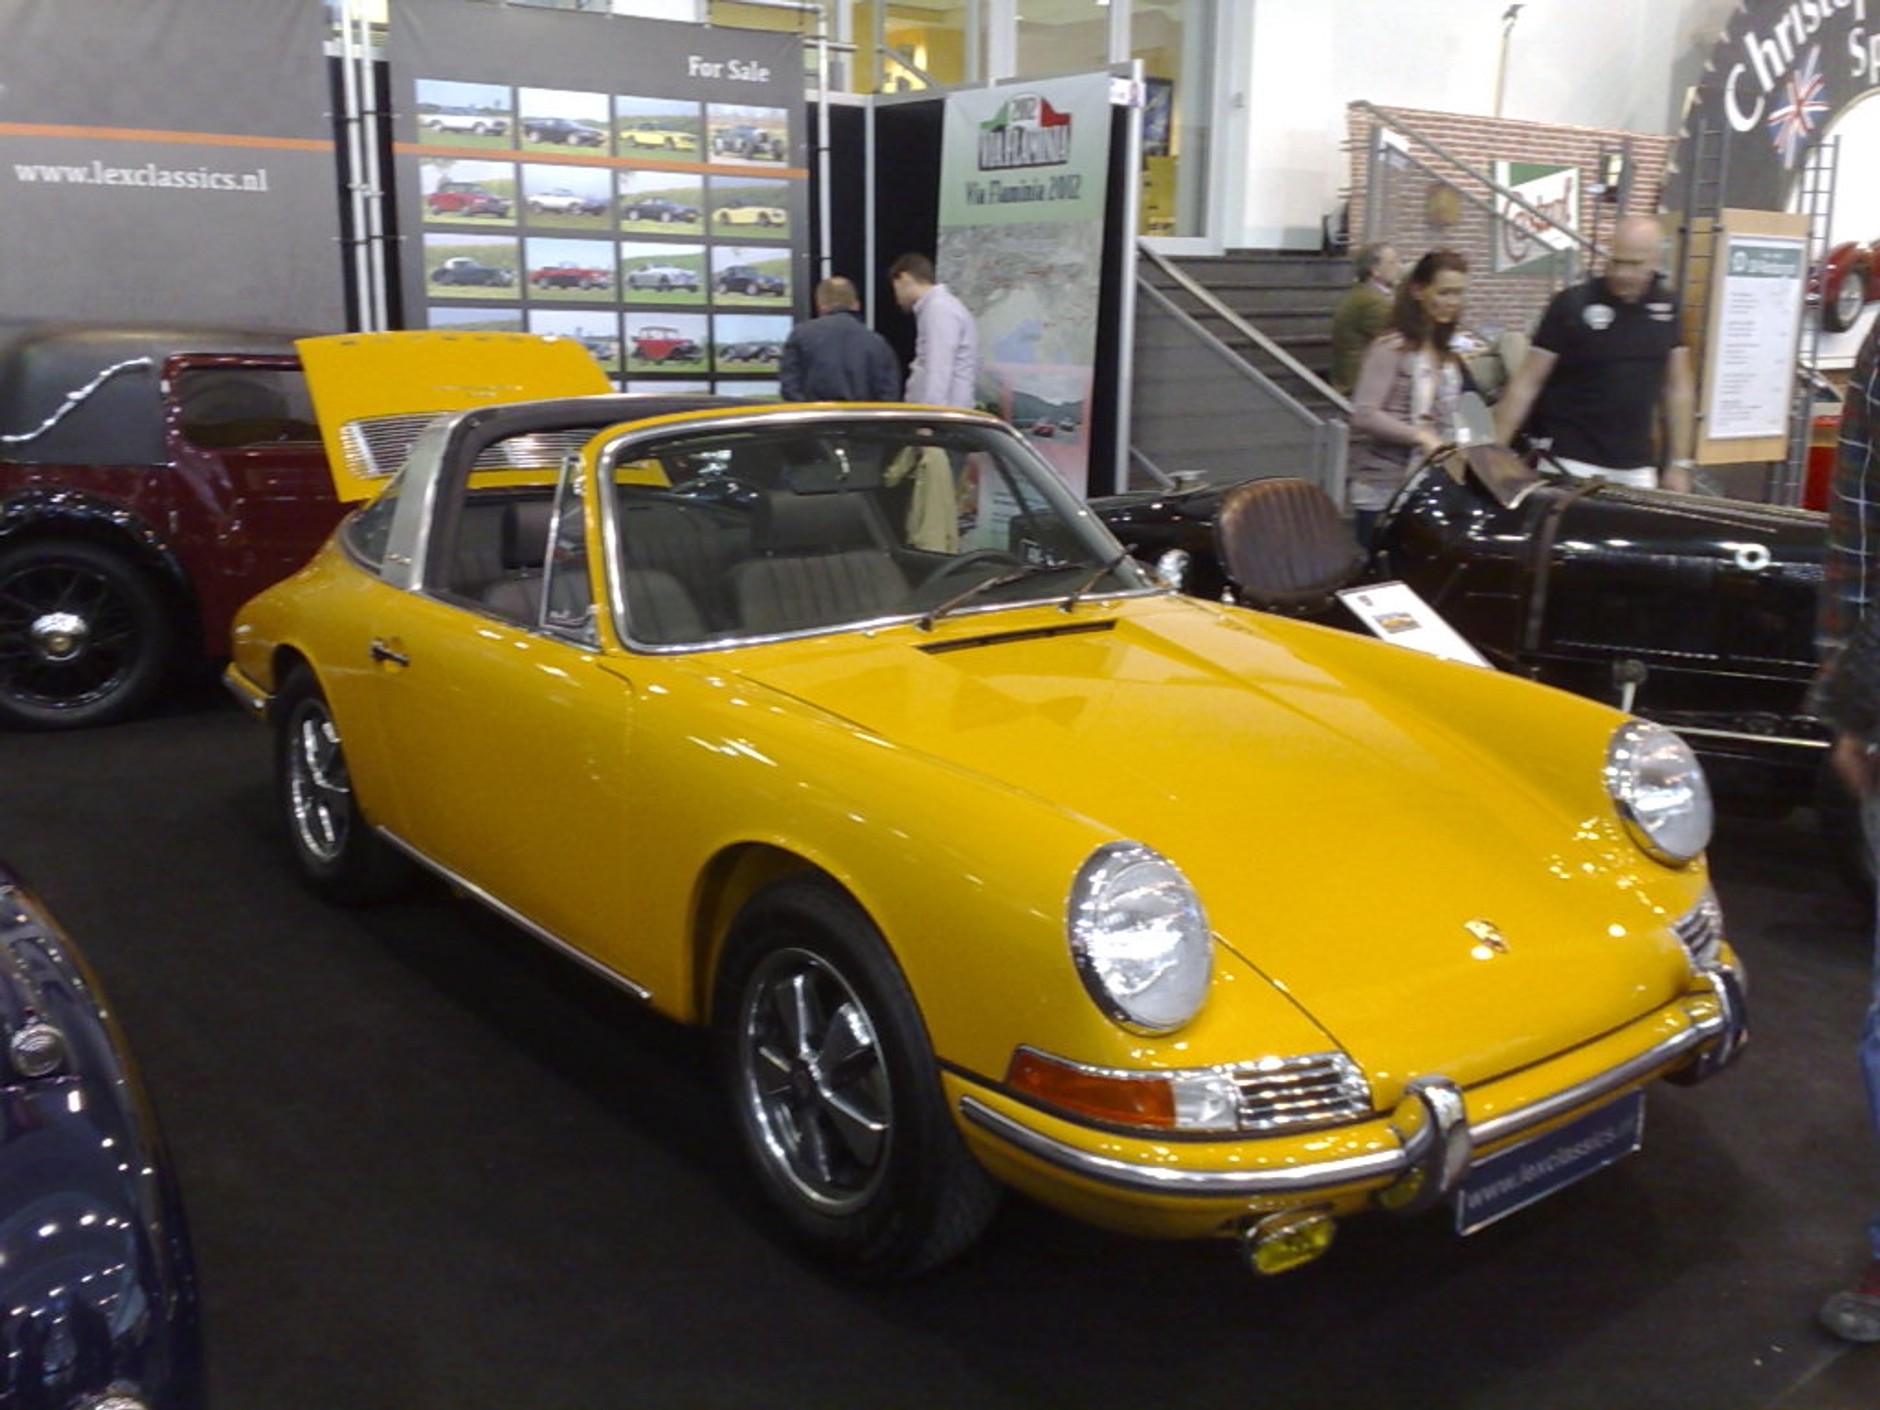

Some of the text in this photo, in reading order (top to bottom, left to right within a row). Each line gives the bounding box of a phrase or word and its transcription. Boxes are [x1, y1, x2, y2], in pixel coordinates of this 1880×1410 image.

[688, 55, 771, 82] For Sale
[13, 159, 268, 192] www.lexclassics.nl
[1048, 174, 1082, 200] 2012
